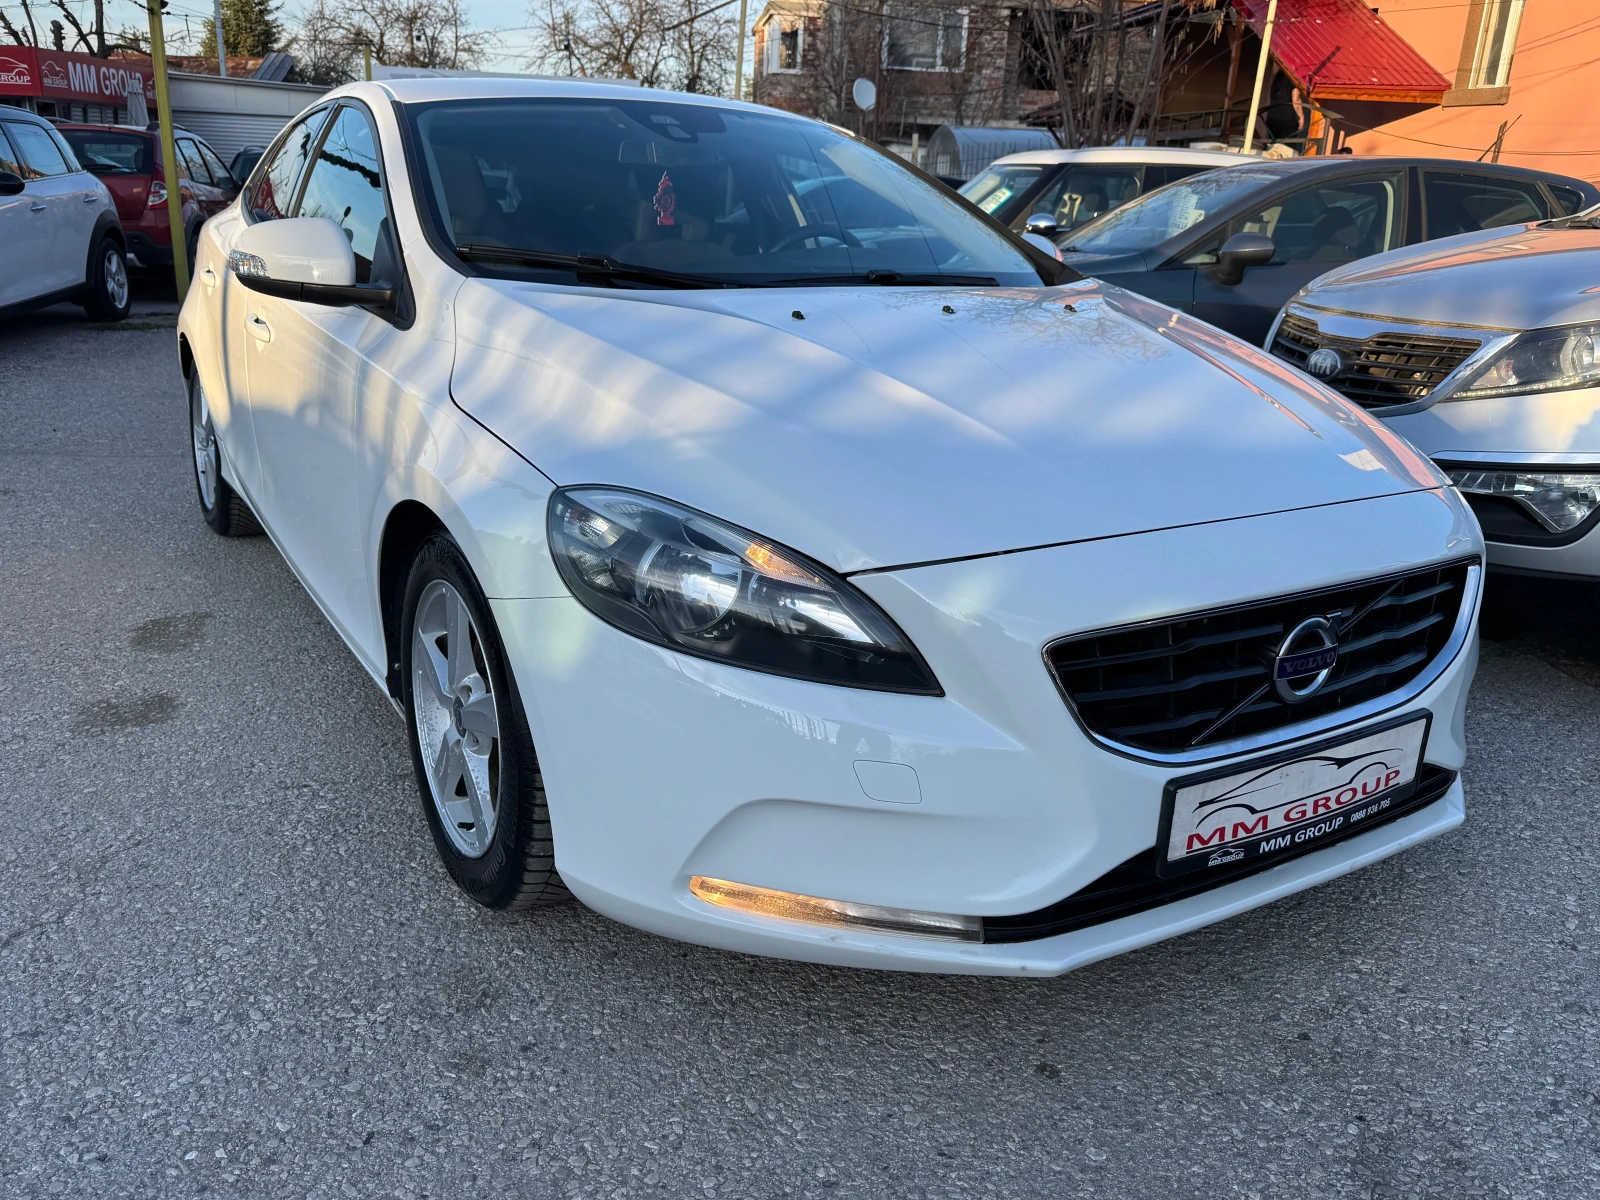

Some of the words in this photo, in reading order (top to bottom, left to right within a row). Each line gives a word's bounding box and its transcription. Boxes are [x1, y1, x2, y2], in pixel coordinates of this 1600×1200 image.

[0, 74, 31, 83] ROUP
[67, 61, 99, 94] MM
[1283, 651, 1335, 673] VOLVO
[1186, 815, 1269, 850] MM
[1283, 769, 1400, 822] GROUP
[1259, 835, 1291, 854] MM
[1295, 816, 1343, 843] GROUP
